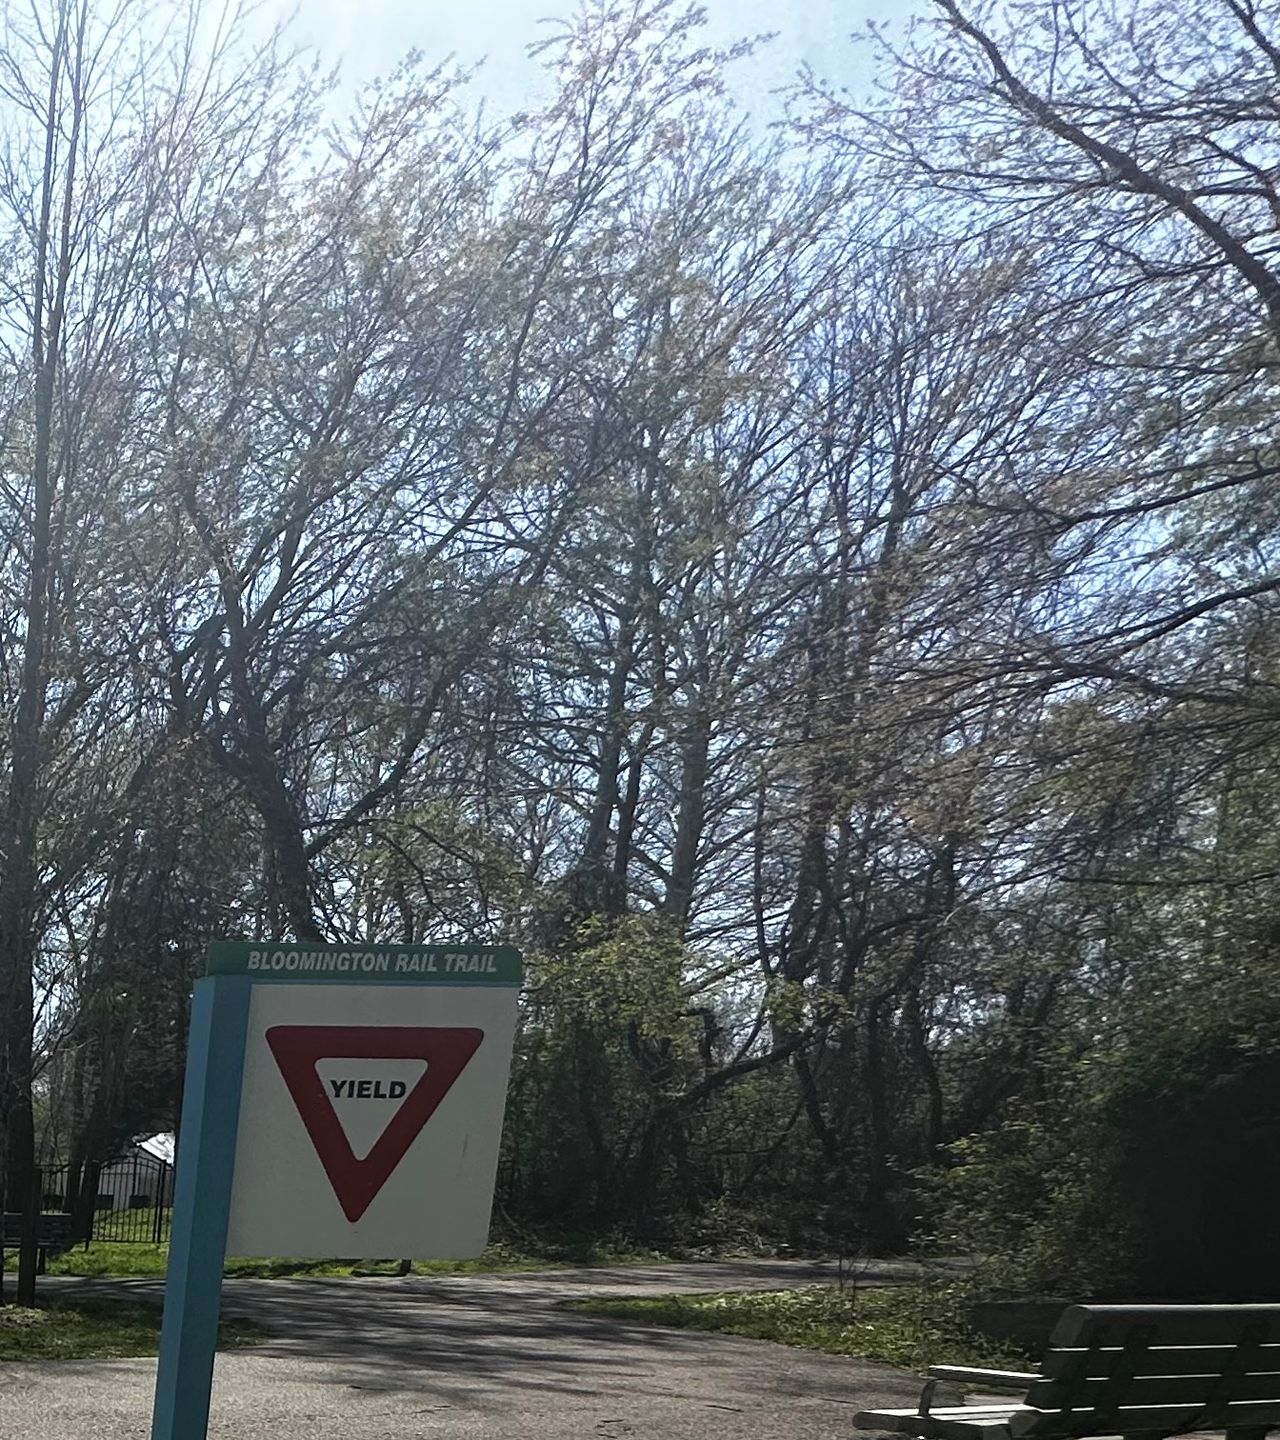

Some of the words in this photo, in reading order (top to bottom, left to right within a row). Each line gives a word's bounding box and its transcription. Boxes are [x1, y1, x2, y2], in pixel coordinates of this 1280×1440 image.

[247, 951, 389, 972] BLOOMINGTON
[394, 954, 438, 972] RAIL
[443, 954, 497, 973] TRAIL
[330, 1080, 407, 1099] YIELD
